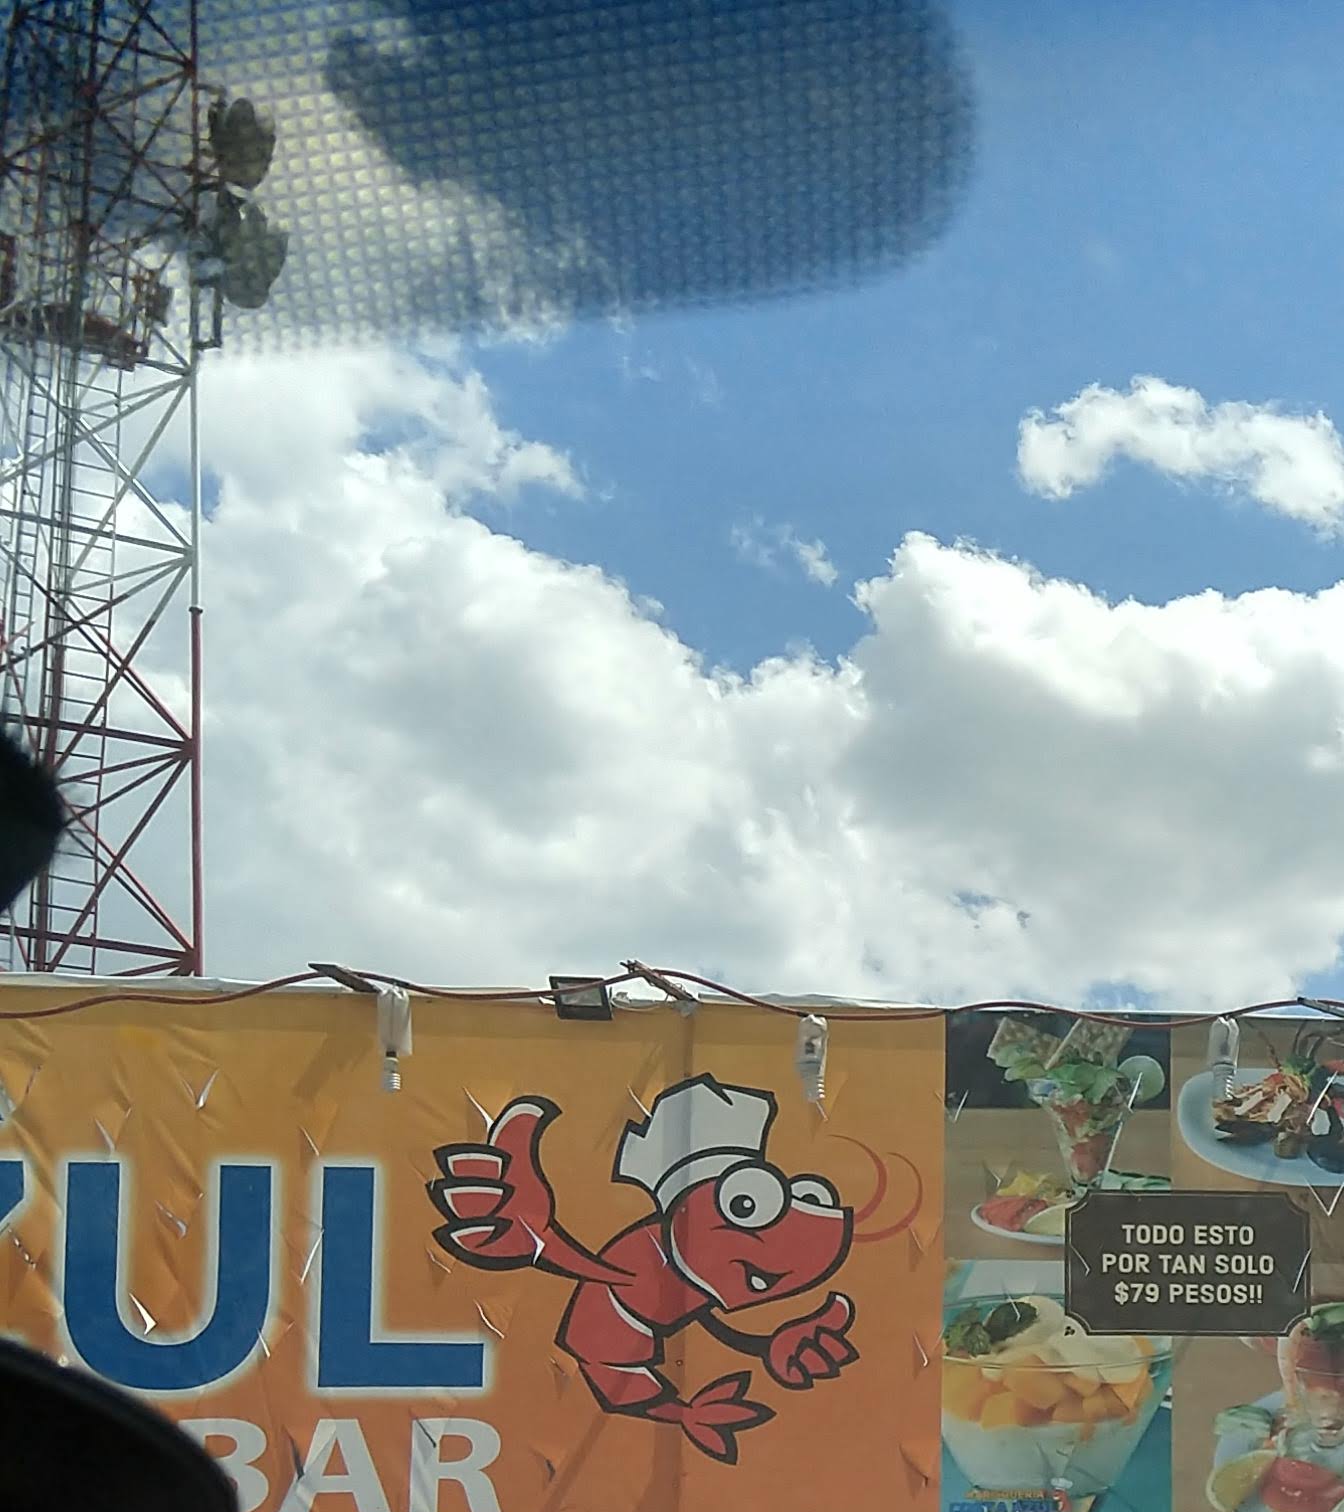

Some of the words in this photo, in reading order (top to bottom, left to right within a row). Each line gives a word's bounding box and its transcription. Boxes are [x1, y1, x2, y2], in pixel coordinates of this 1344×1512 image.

[1122, 1223, 1186, 1247] TODO
[1195, 1223, 1255, 1247] ESTO
[0, 1160, 484, 1391] UL
[1101, 1253, 1153, 1276] POR
[1160, 1253, 1207, 1275] TAN
[1214, 1253, 1274, 1276] SOLO
[1114, 1282, 1160, 1306] $79
[1168, 1282, 1263, 1305] PESOS!!
